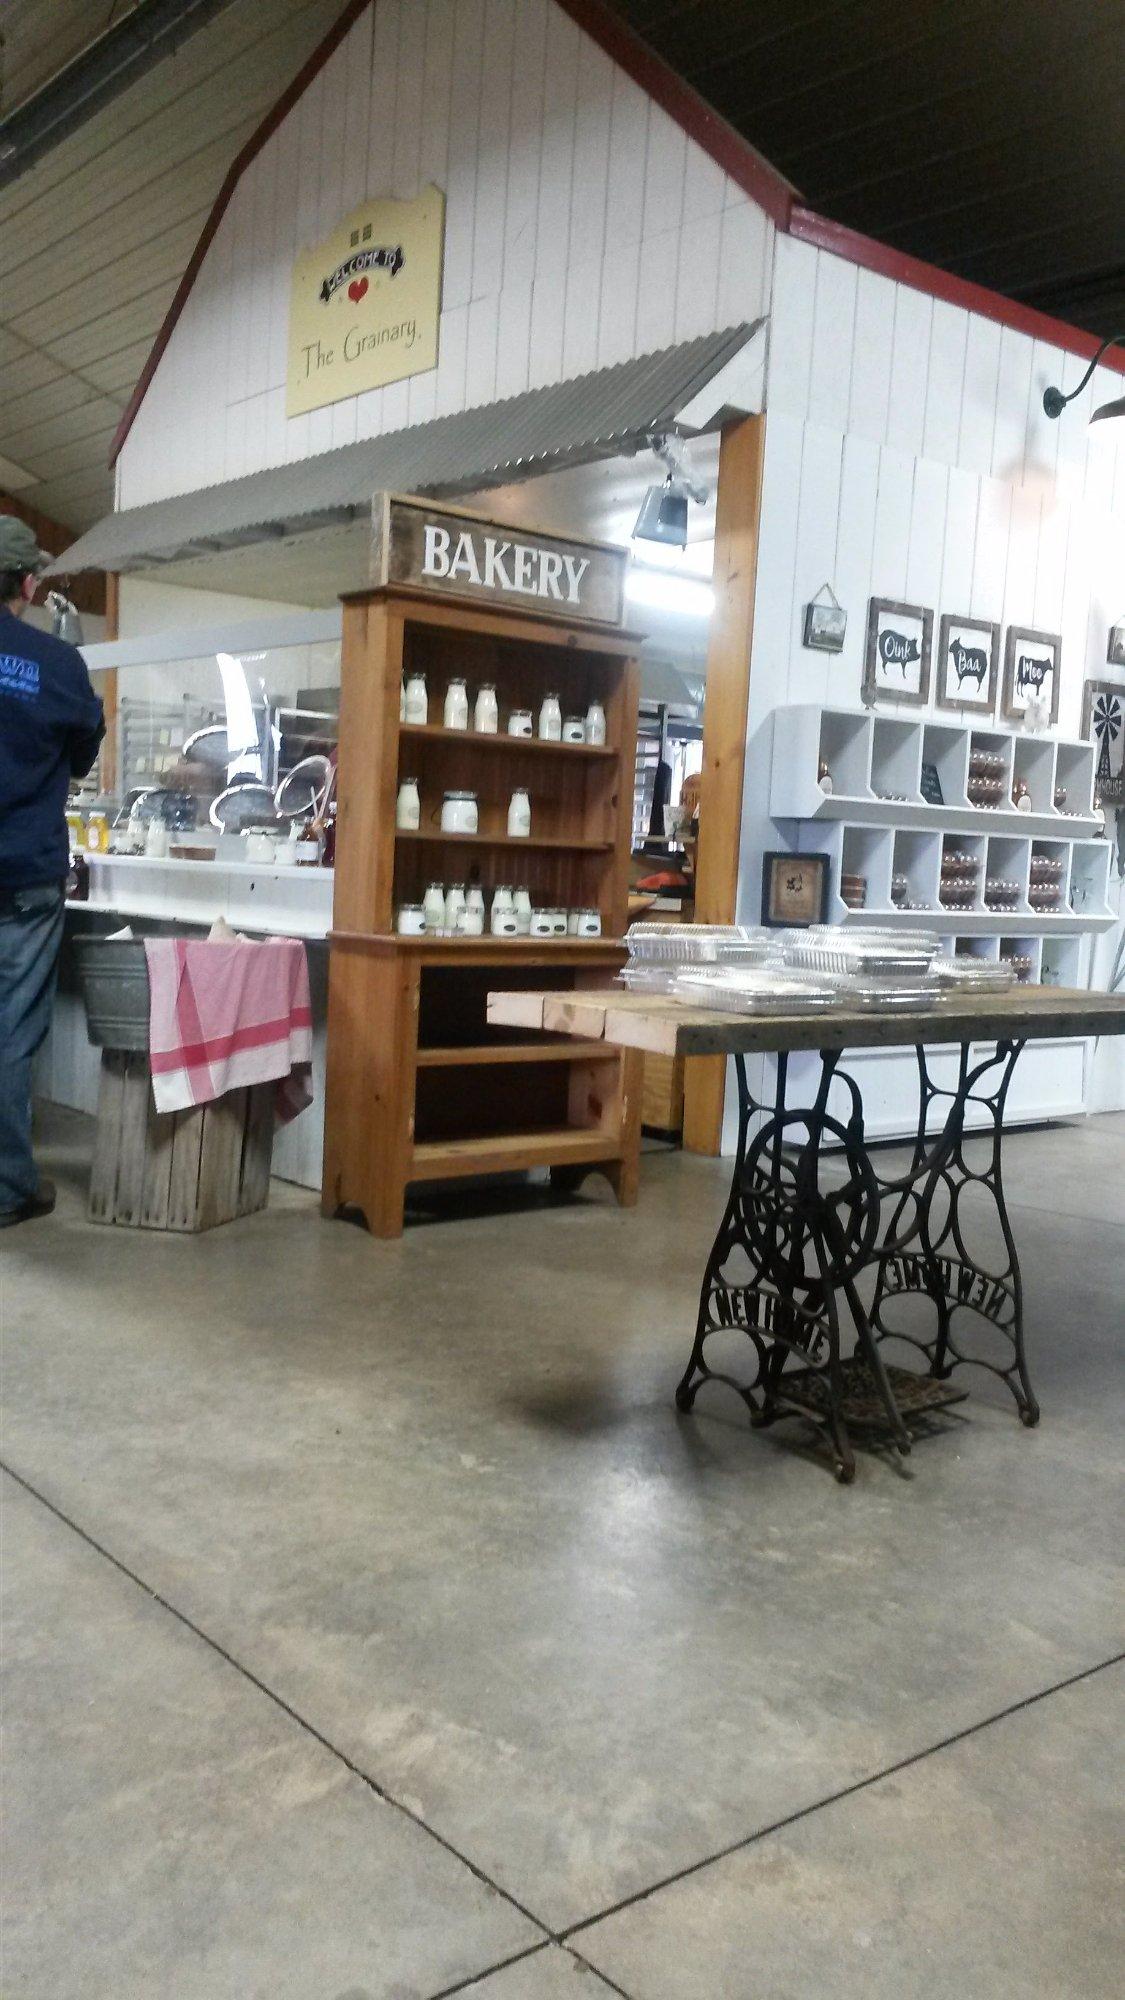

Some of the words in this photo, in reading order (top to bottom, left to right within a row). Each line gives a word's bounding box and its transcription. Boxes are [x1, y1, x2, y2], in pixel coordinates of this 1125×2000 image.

[327, 251, 380, 293] WELCOME
[383, 250, 398, 267] TO
[301, 340, 334, 378] The
[421, 524, 590, 604] BAKERY
[884, 636, 911, 661] Oink
[957, 650, 981, 675] Baa
[1022, 659, 1043, 682] Moo
